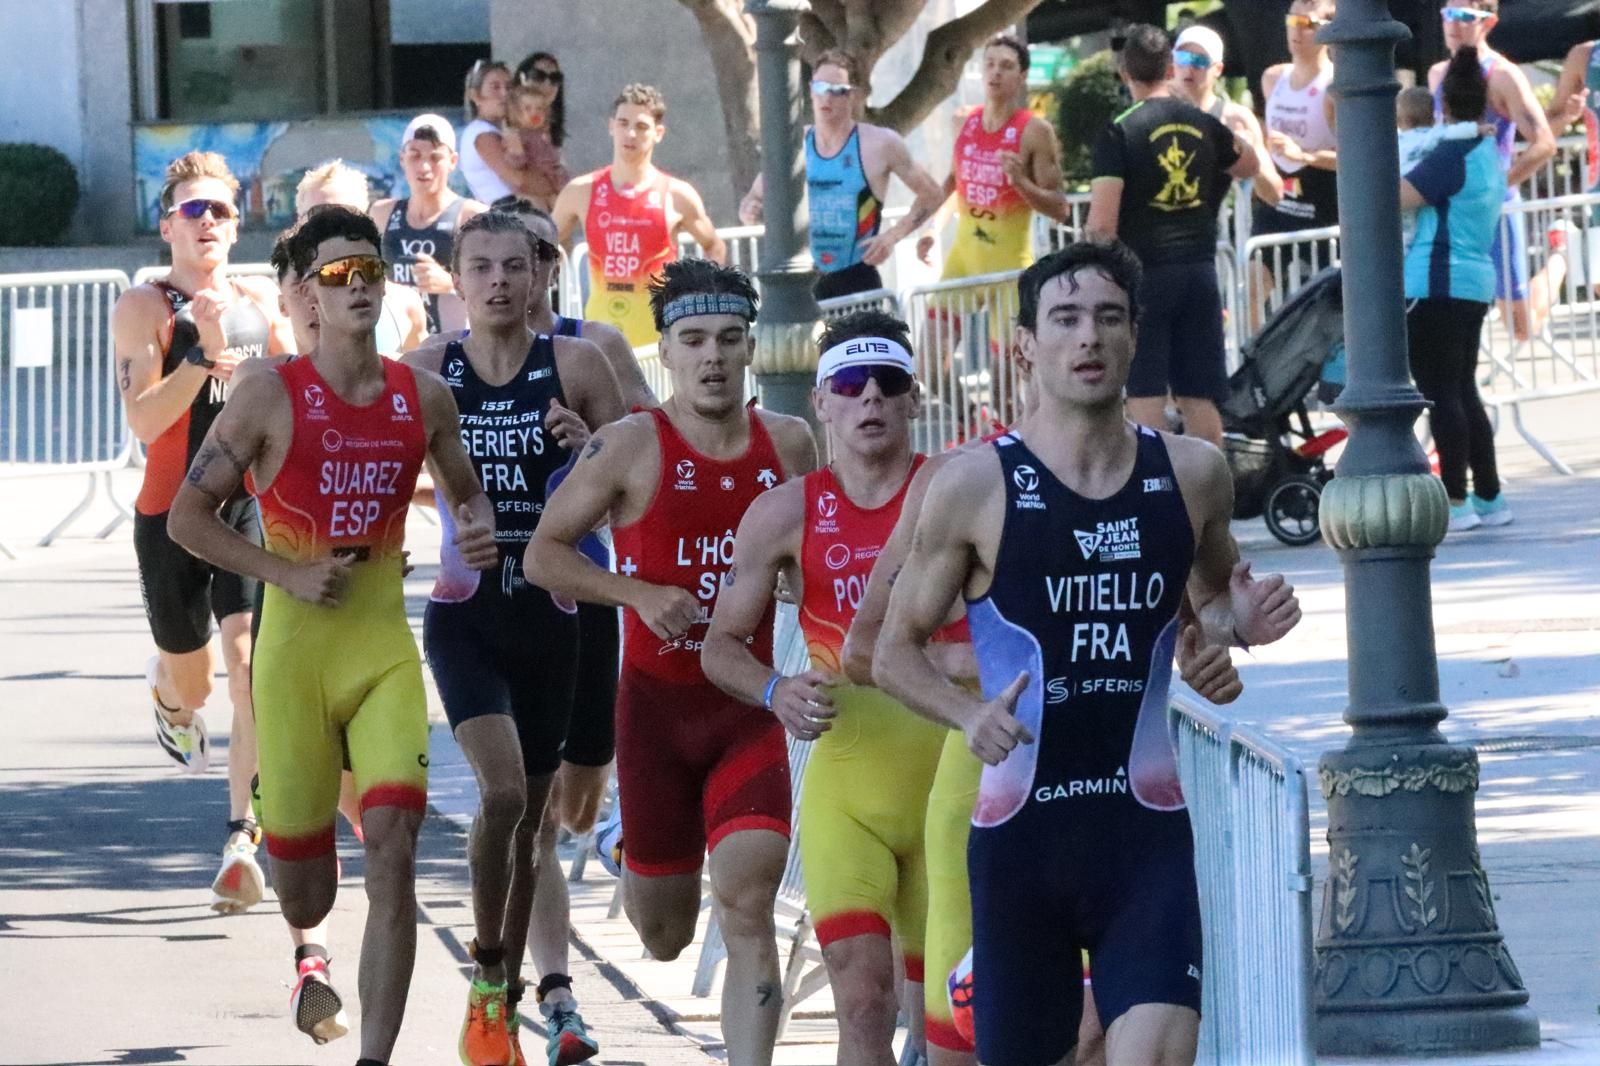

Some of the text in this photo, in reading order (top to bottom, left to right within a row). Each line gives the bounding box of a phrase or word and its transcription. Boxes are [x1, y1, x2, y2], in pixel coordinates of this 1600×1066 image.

[966, 182, 998, 206] ESP
[606, 232, 640, 254] VELA
[604, 255, 640, 278] ESP
[846, 342, 889, 356] ELITE
[460, 426, 545, 457] SERIEYS
[320, 460, 402, 495] SUAREZ
[481, 463, 529, 492] FRA
[1016, 500, 1047, 510] Triathlon
[1019, 493, 1041, 501] World
[330, 500, 380, 537] ESP
[815, 525, 840, 534] Triathlon
[818, 519, 836, 527] World
[1097, 517, 1138, 534] SAINT
[1104, 530, 1140, 545] JEAN
[1111, 542, 1140, 551] MONTS
[1045, 571, 1165, 613] VITIELLO
[1071, 622, 1132, 663] FRA
[1035, 777, 1127, 802] GARMIN
